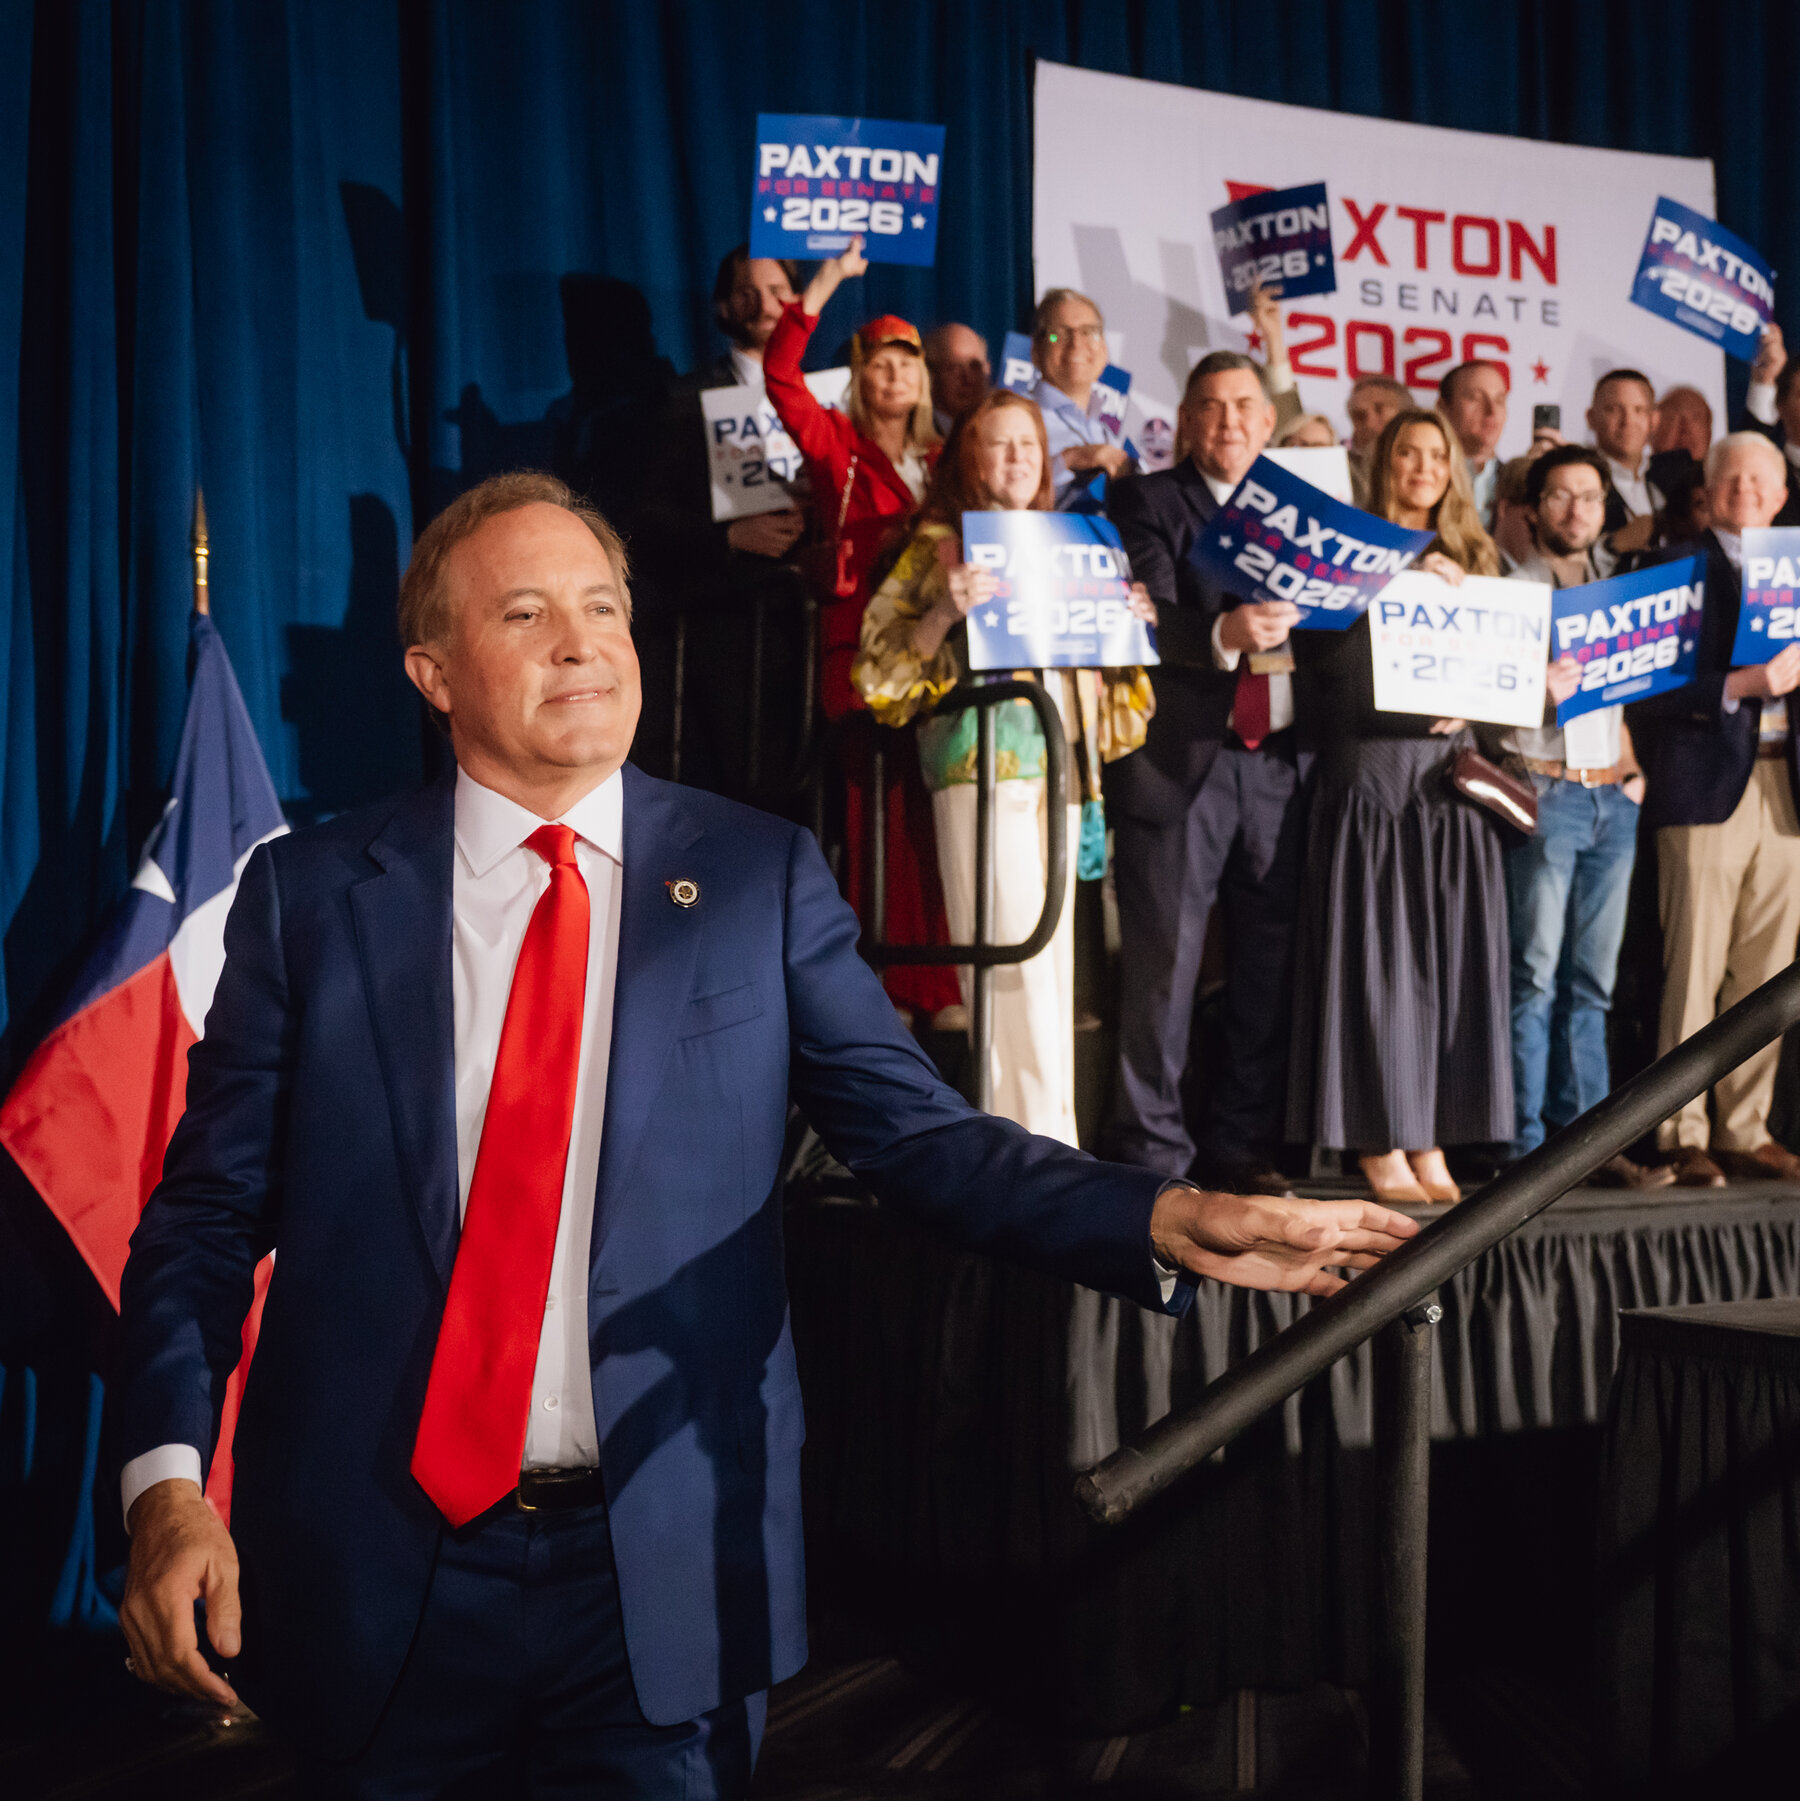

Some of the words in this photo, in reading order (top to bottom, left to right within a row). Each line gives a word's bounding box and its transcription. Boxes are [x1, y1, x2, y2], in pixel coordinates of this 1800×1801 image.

[759, 143, 939, 186] PAXTON
[781, 198, 904, 235] 2026
[1340, 197, 1557, 286] XTON
[1652, 216, 1775, 311] PAXTON
[1360, 279, 1561, 327] SENATE
[1660, 268, 1760, 335] 2026
[1235, 479, 1415, 576] PAXTON
[1234, 543, 1358, 611] 2026
[1748, 556, 1800, 589] PA
[1379, 601, 1543, 643] PAXTON
[1555, 581, 1704, 650] PAXTON
[1581, 635, 1680, 692] 2026
